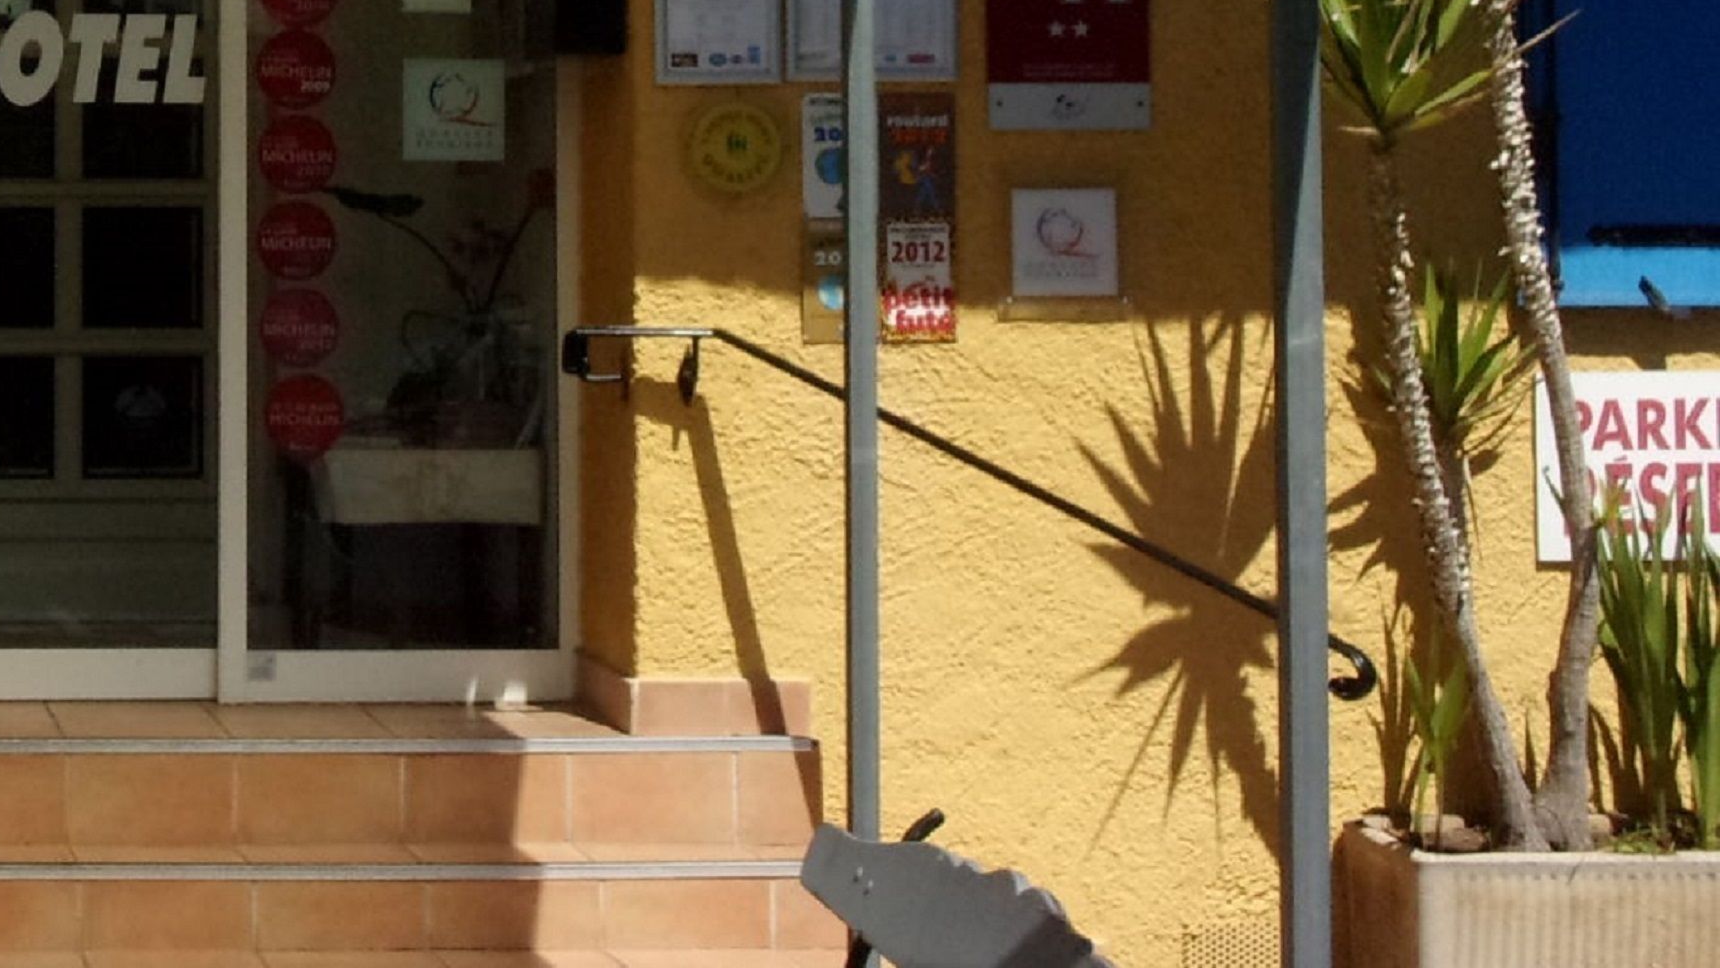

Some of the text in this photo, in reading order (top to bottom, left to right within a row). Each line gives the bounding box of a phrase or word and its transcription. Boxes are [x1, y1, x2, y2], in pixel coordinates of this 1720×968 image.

[814, 126, 842, 142] 20
[813, 250, 842, 266] 20
[891, 241, 945, 263] 2012
